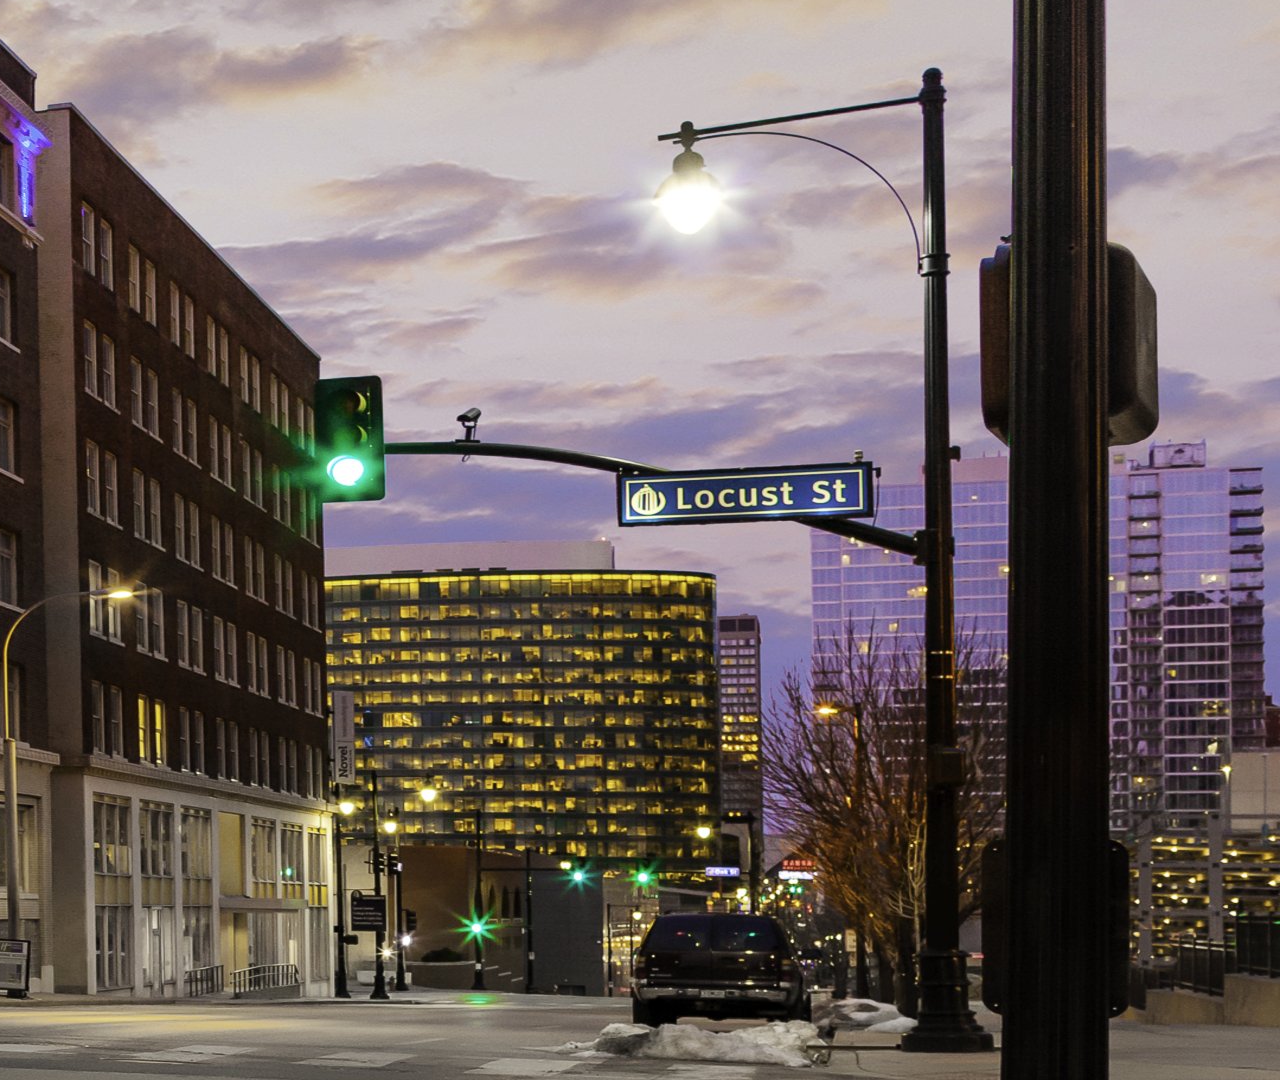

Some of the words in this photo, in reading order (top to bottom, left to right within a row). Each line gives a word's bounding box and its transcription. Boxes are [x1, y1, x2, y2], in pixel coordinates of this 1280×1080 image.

[676, 481, 794, 510] Locust
[811, 479, 847, 504] St
[338, 745, 348, 778] Novel
